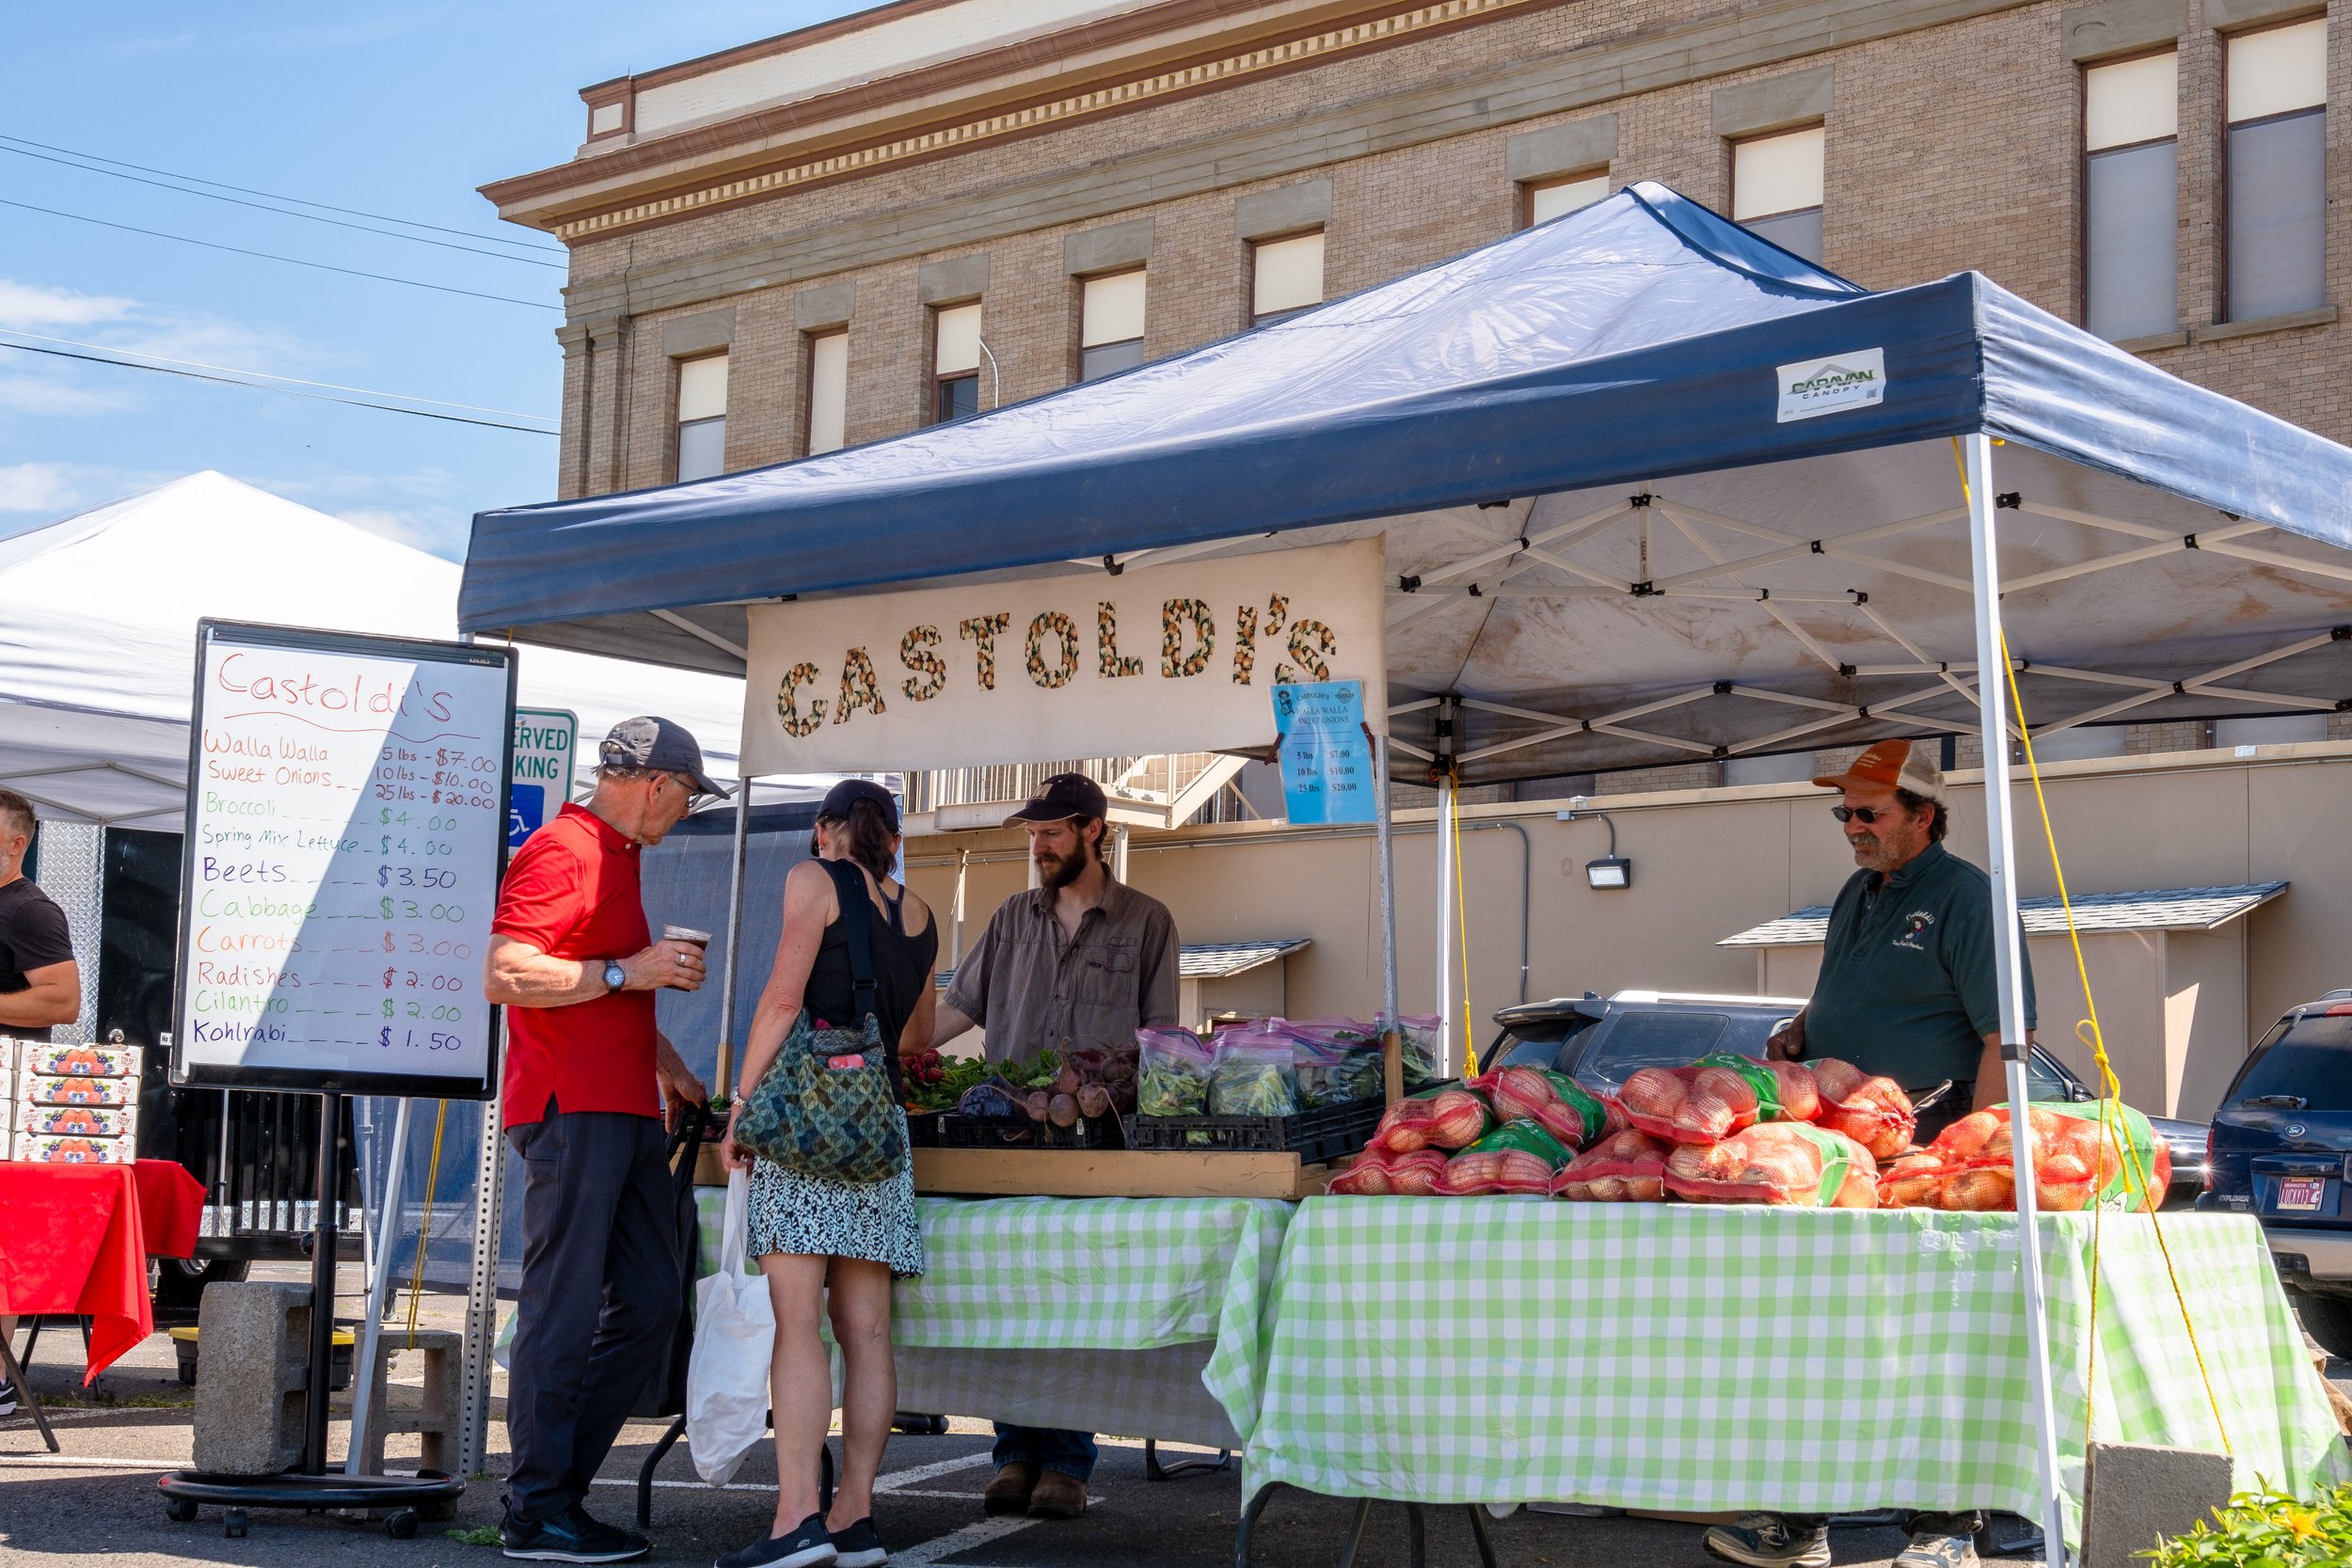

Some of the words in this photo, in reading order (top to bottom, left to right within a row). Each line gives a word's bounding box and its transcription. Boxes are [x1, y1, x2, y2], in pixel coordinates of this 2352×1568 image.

[1802, 385, 1860, 400] CANOPY
[777, 592, 1336, 738] CASTOLDI'S
[218, 653, 453, 722] Castoldi's
[203, 729, 273, 759] Walla
[279, 736, 328, 762] Walla
[382, 747, 393, 761] 5
[208, 760, 265, 784] Sweet
[275, 767, 332, 787] Onions
[1307, 768, 1318, 776] lbs
[1329, 767, 1355, 775] $10.00
[1309, 784, 1320, 792] lbs
[1331, 783, 1357, 791] $20.00
[206, 791, 276, 816] Broccoli
[202, 824, 252, 849] Spring
[297, 830, 358, 852] Lettuce
[203, 857, 287, 883] Beets
[199, 889, 318, 925] Cabbage
[197, 926, 303, 954] Carrots
[199, 961, 302, 989] Radishes
[195, 990, 289, 1014] Cilantro
[194, 1019, 287, 1043] Kohlrabi
